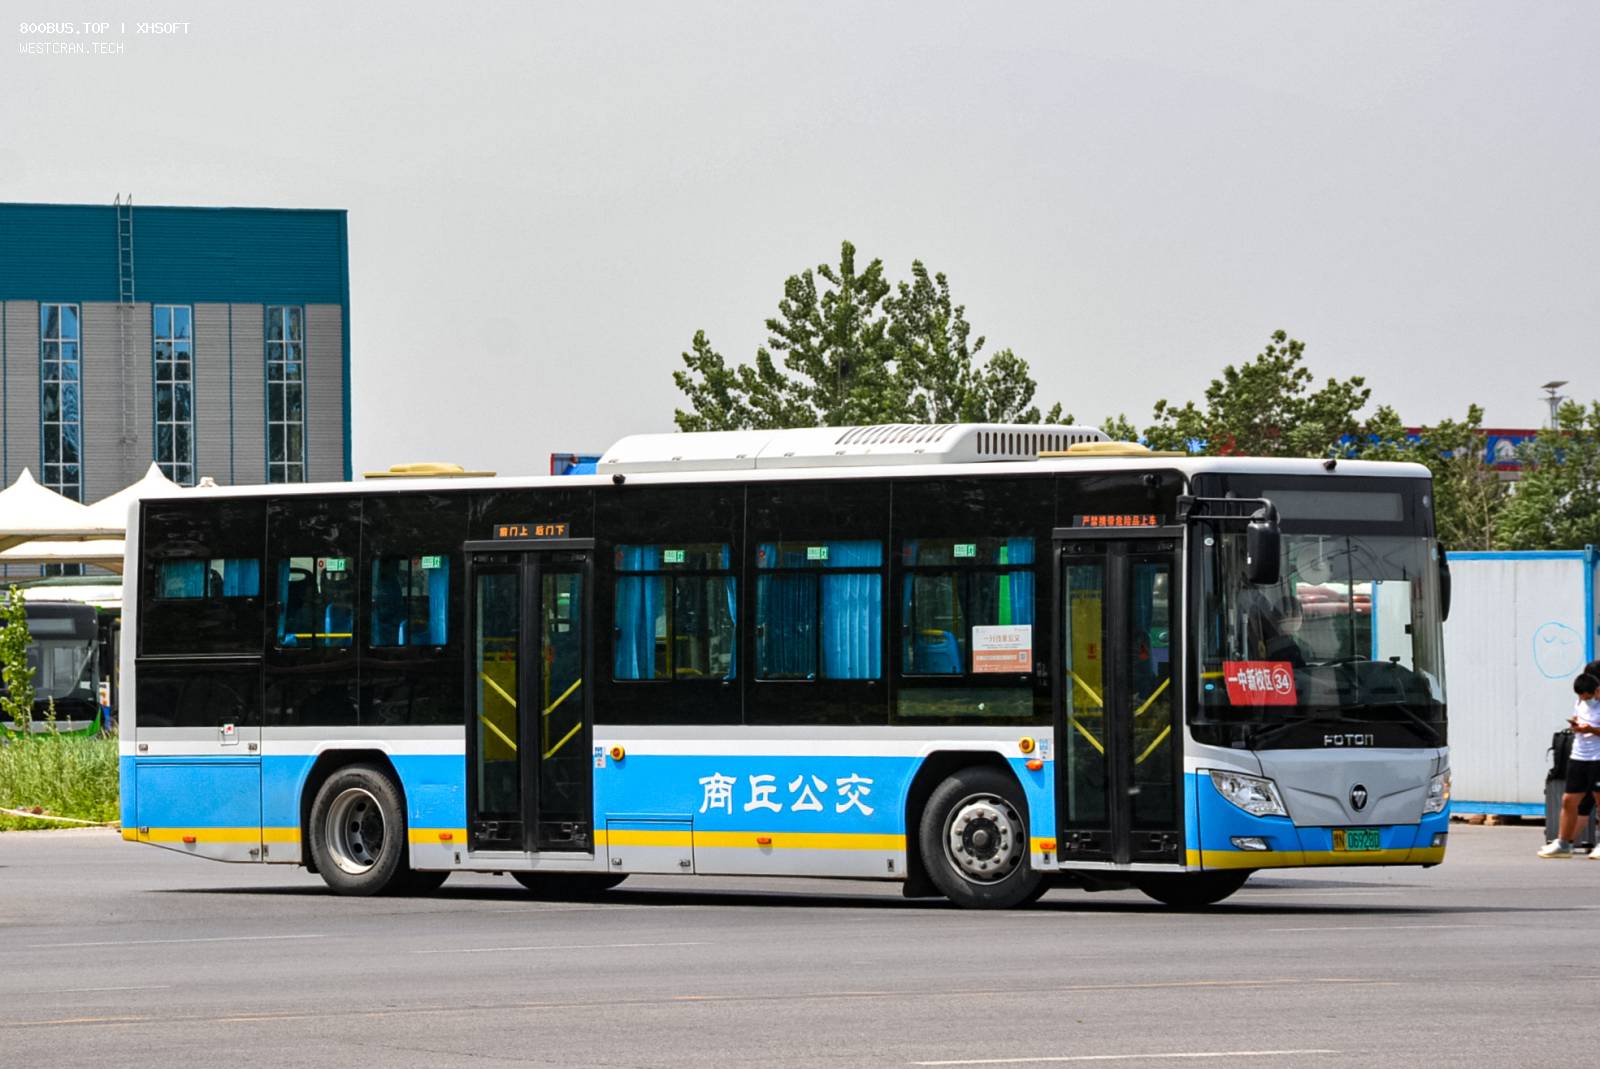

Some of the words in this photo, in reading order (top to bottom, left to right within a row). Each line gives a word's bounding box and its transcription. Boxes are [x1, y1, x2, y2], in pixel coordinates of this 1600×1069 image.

[1228, 667, 1274, 692] 一中新校区
[1274, 673, 1289, 689] 34
[1323, 734, 1374, 746] FOTON
[698, 772, 875, 816] 商丘公交
